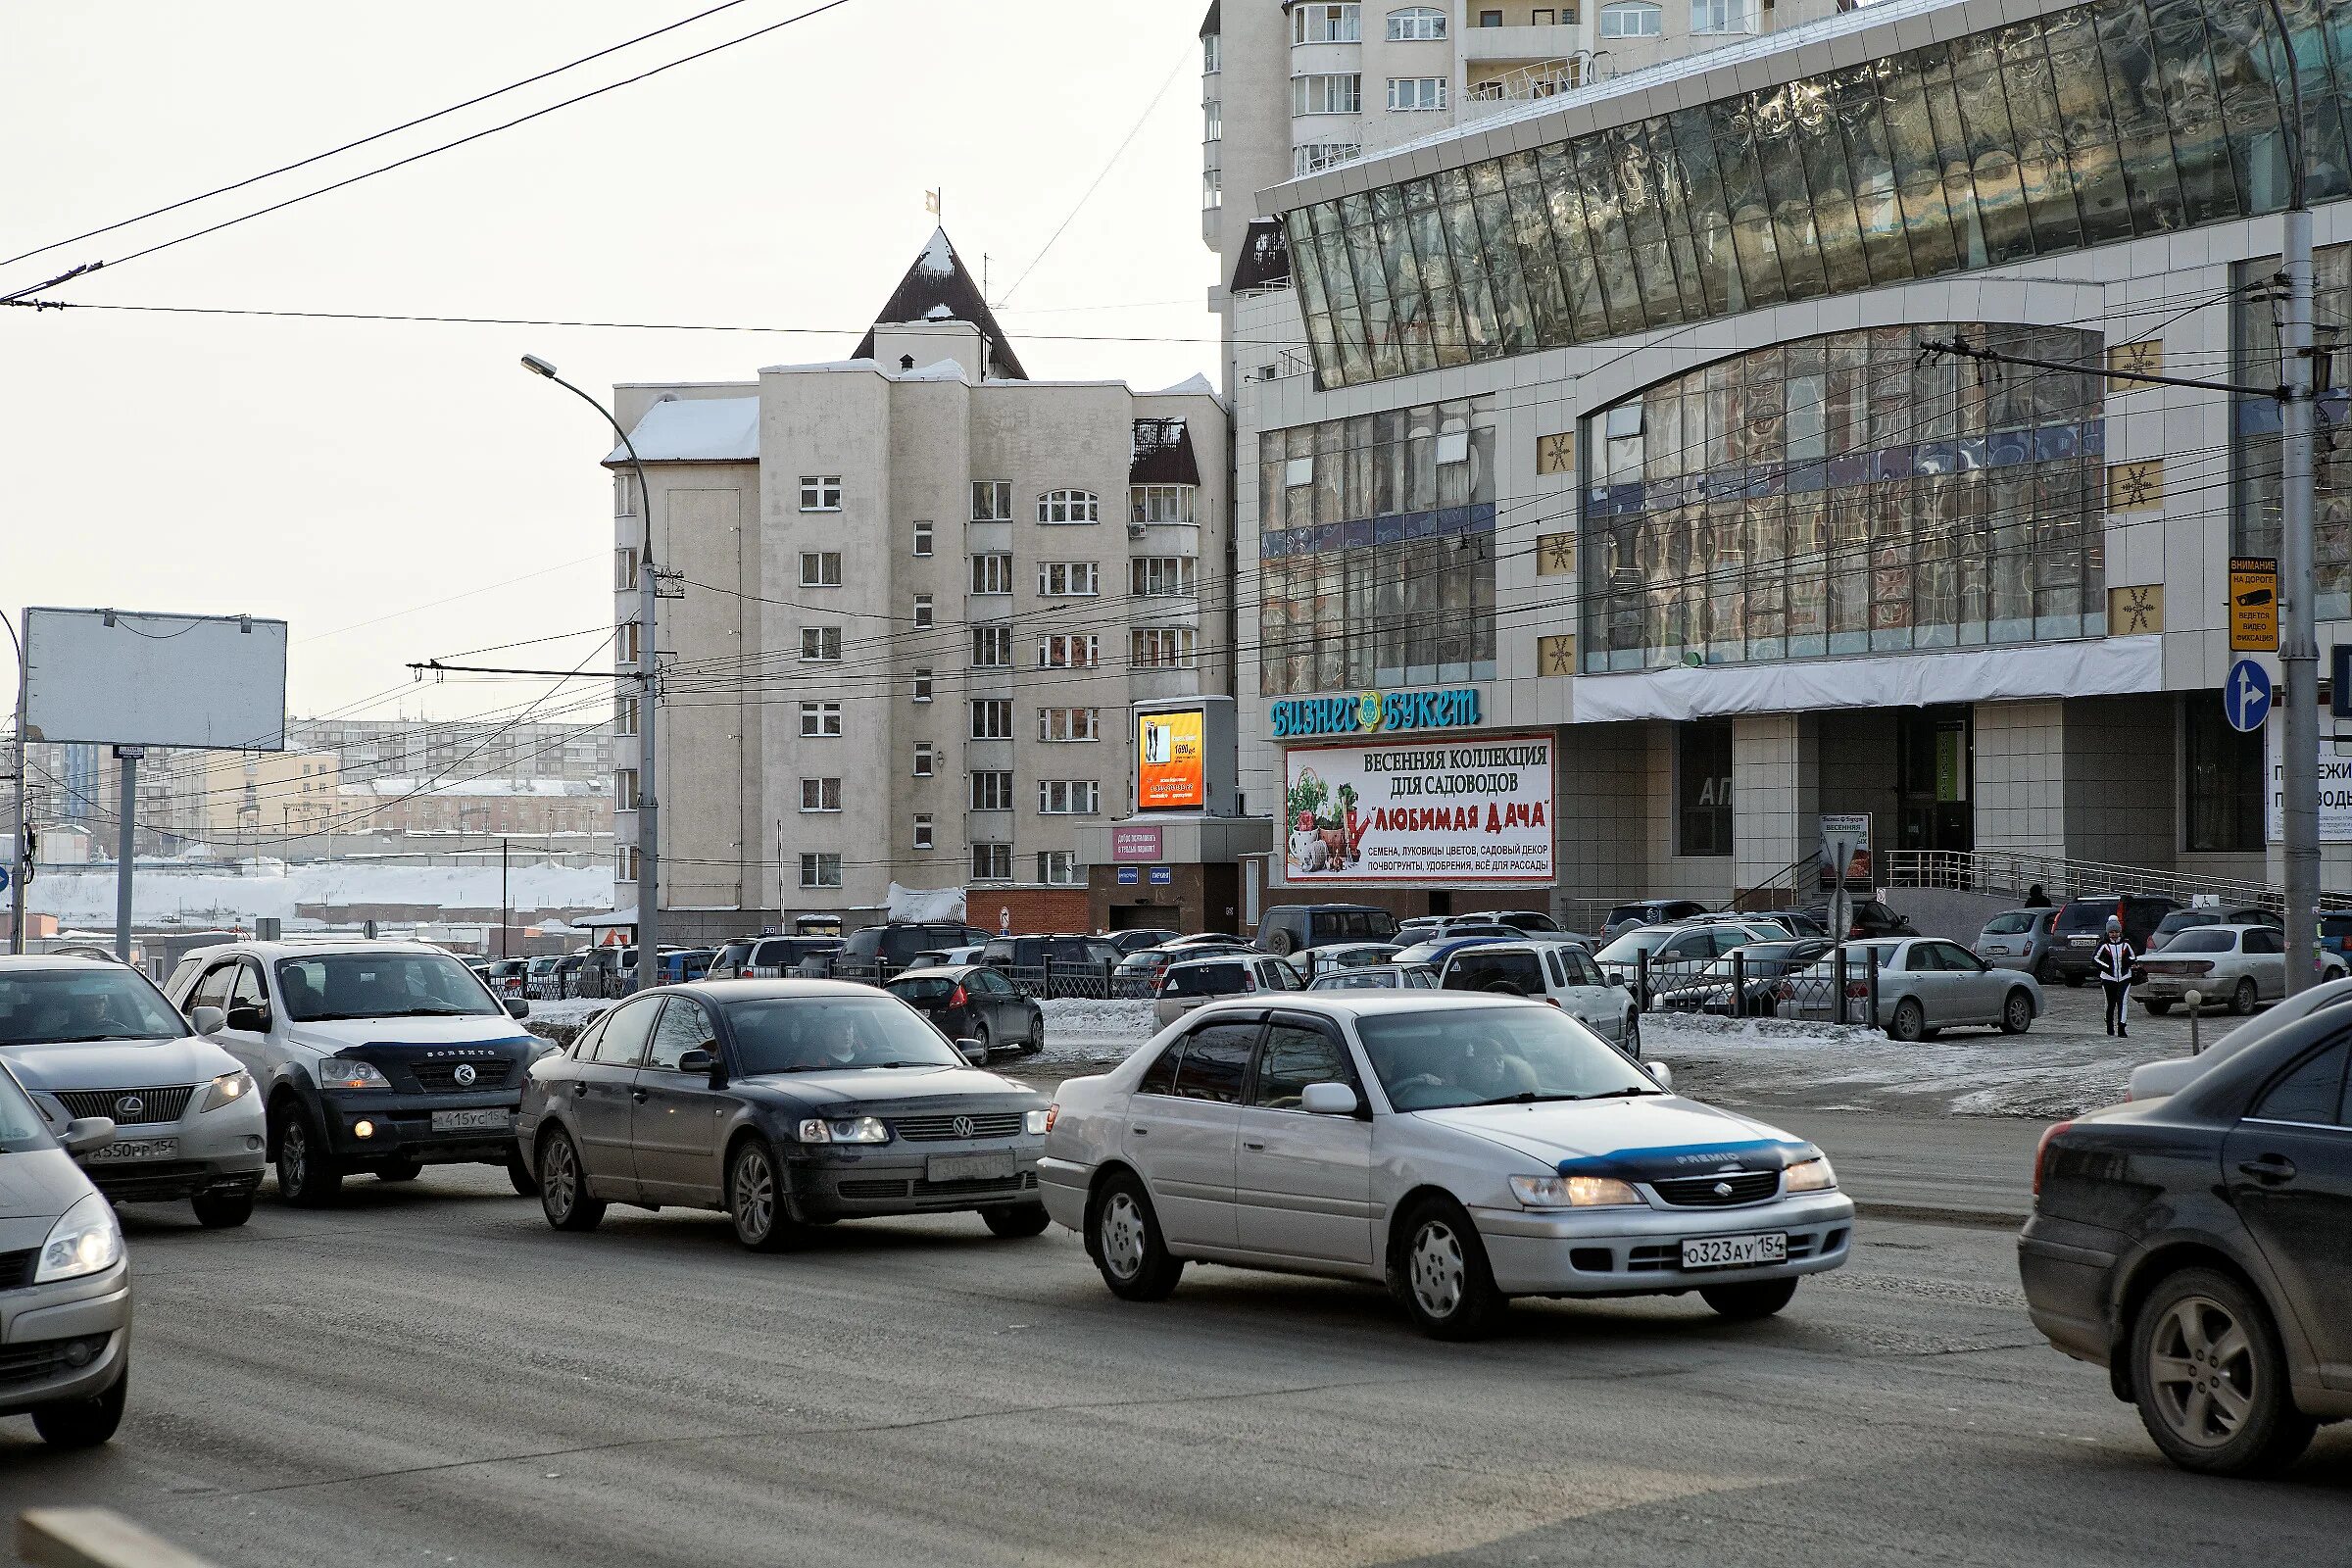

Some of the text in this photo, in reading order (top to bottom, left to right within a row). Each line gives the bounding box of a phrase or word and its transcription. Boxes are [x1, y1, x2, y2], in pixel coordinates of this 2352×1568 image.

[2230, 560, 2276, 570] ВНИМАНИЕ
[1364, 746, 1547, 772] ВЕСЕННЯЯ КОЛЛЕКЦИЯ
[1391, 772, 1519, 800] ДЛЯ САДОВОДОВ
[1372, 799, 1549, 834] "ЛЮБИМАЯ ДАЧА"
[1367, 843, 1548, 858] СЕМЕНА, ЛУКОВИЦЫ ЦВЕТОВ, САДОВЫЙ ДЕКОР
[1367, 858, 1548, 872] ПОЧВОГРУНТЫ, УДОБРЕНИЯ, ВСЁ ДЛЯ РАССАДЫ
[1688, 1236, 1785, 1264] О323АУ 154
